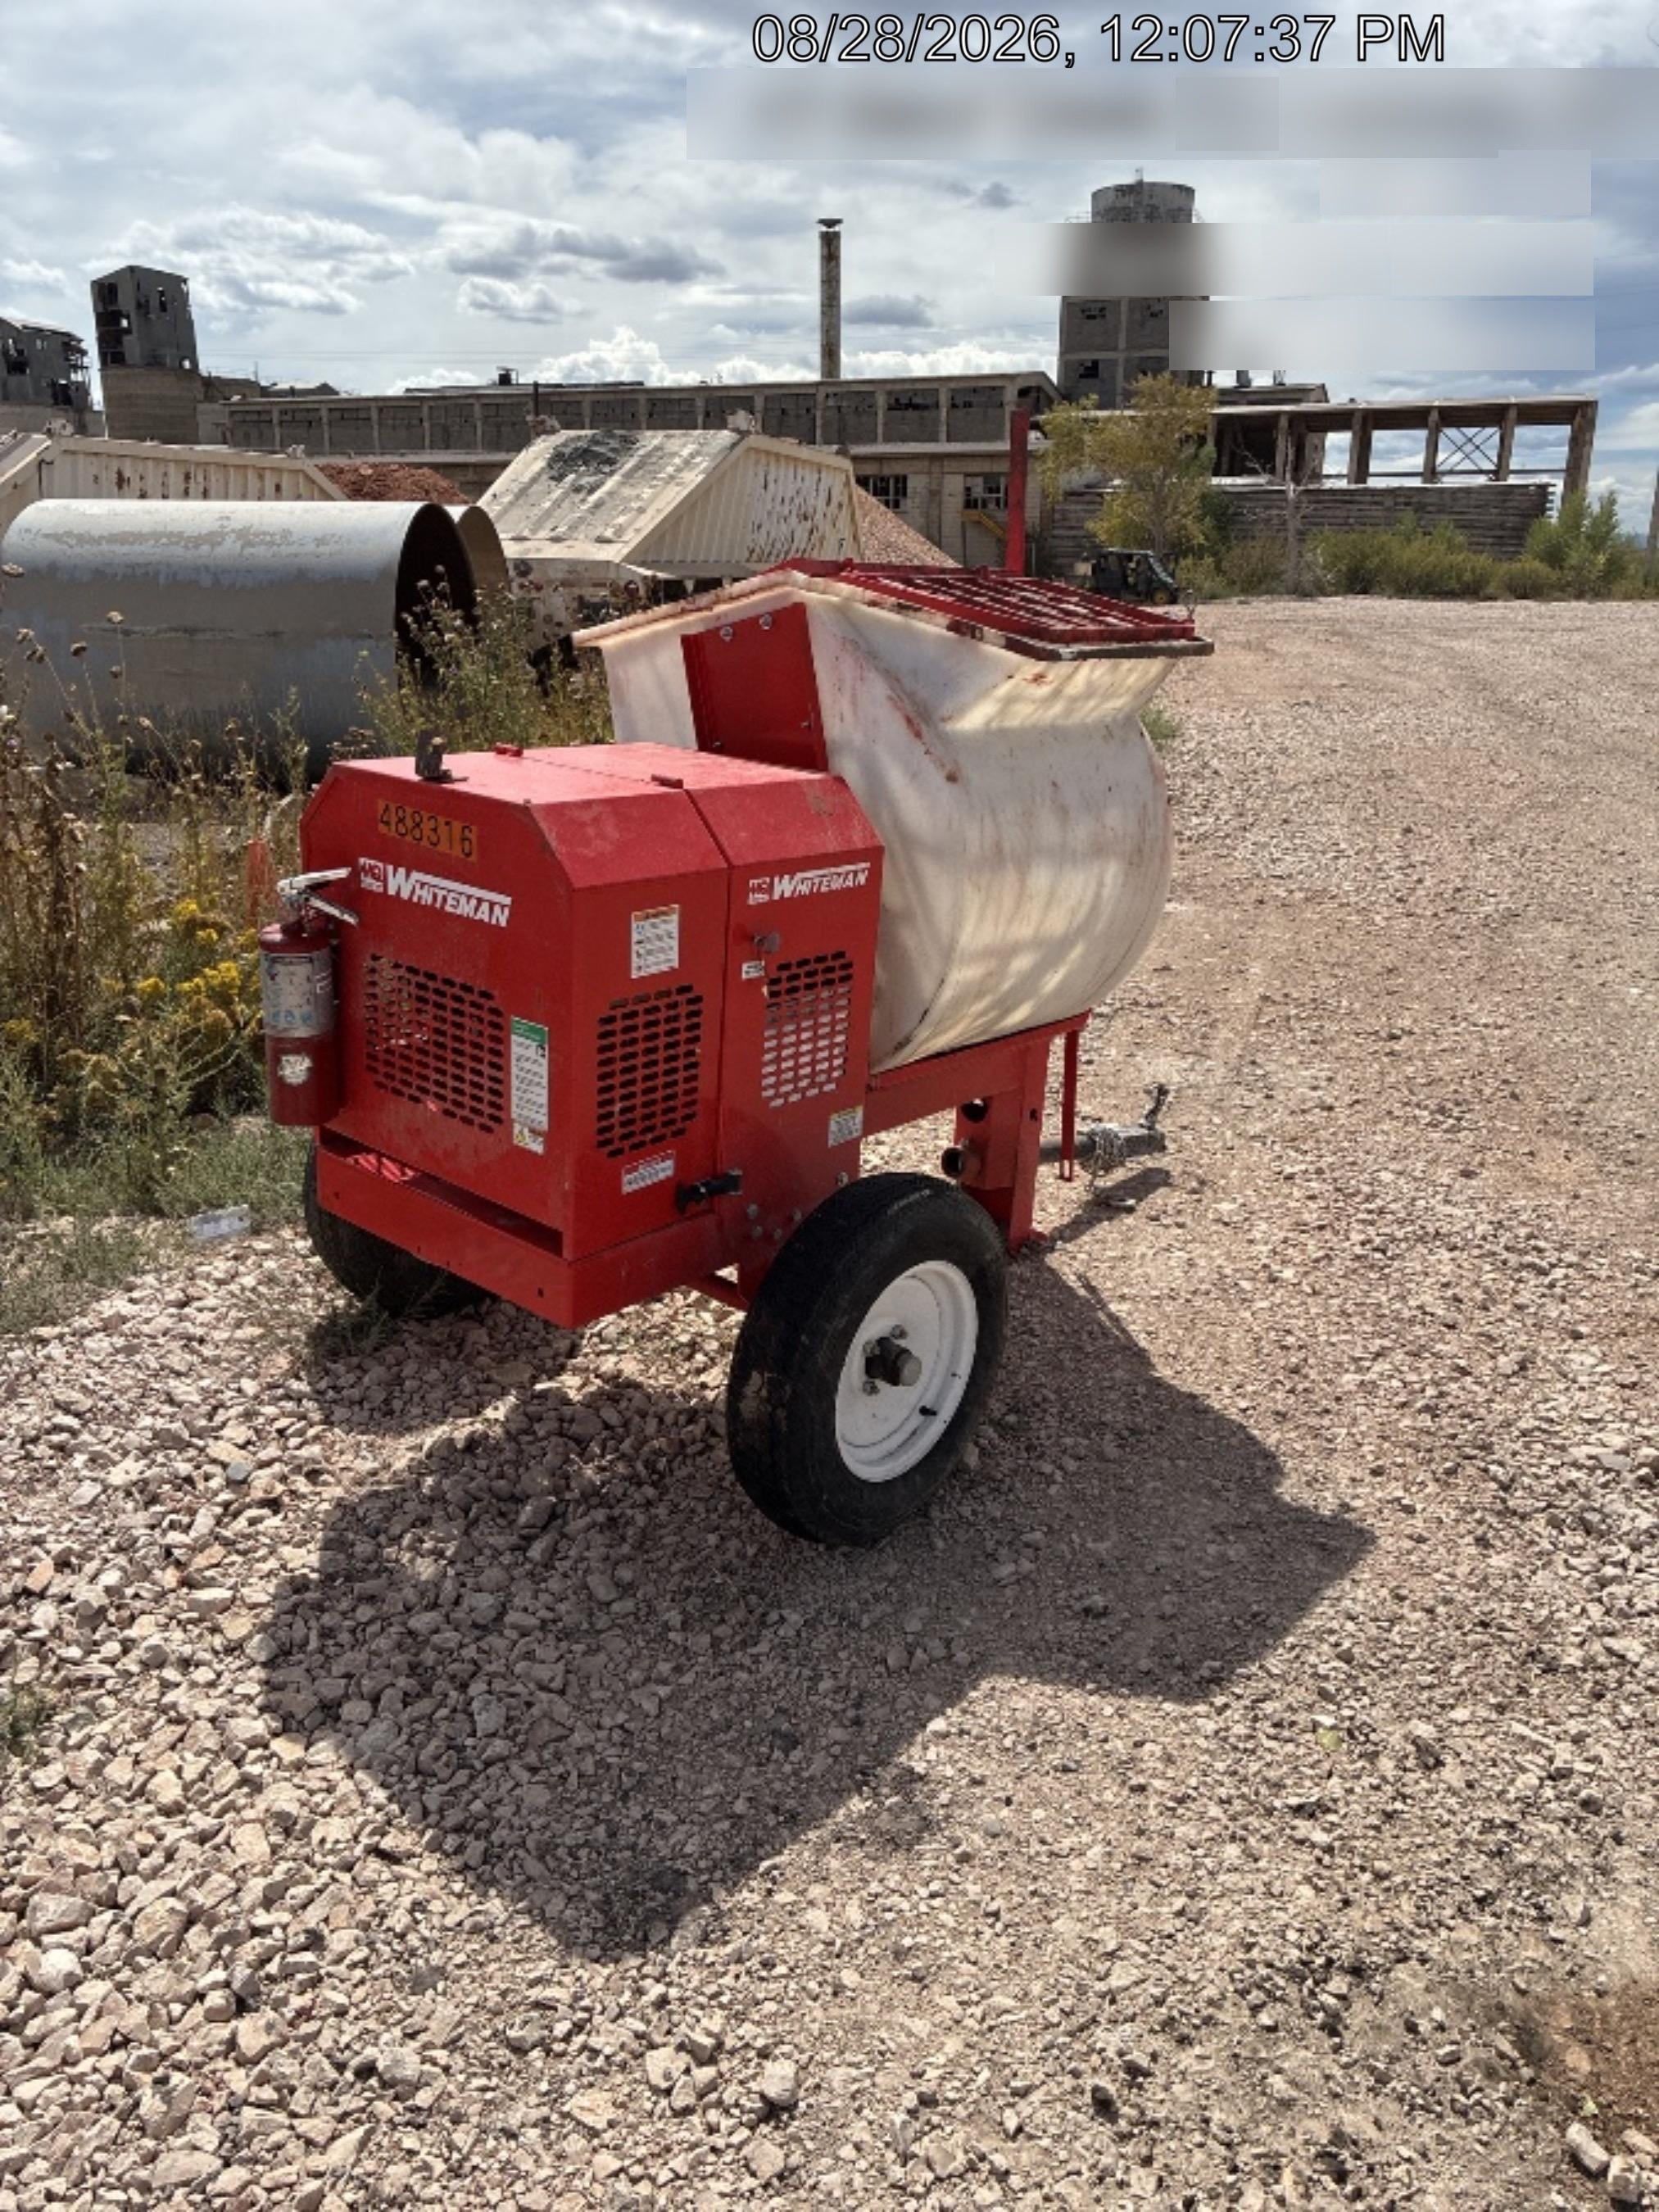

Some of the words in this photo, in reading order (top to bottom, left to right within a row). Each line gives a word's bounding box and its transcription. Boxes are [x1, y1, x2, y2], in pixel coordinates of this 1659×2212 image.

[379, 802, 474, 858] 488316
[386, 864, 512, 927] WHITEMAN
[772, 863, 870, 900] WHITEMAN
